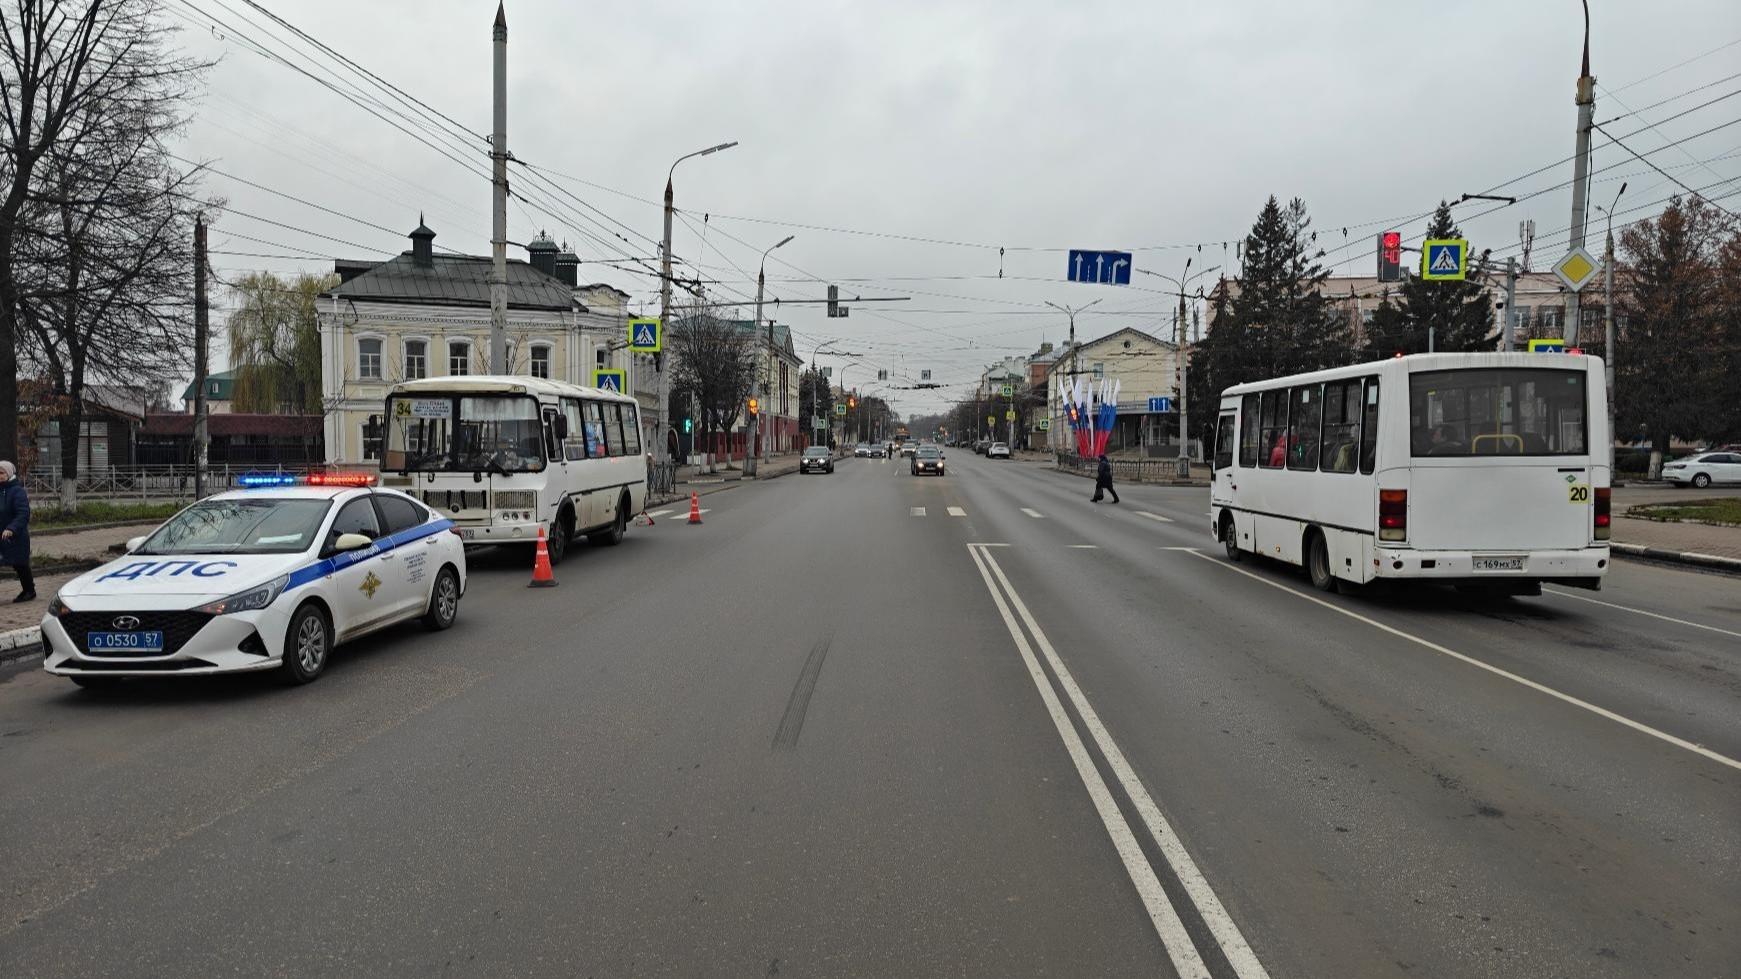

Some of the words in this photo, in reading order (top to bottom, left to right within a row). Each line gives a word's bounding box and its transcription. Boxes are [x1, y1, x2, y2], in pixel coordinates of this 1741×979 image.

[396, 402, 412, 416] 34
[1570, 486, 1588, 502] 20
[94, 560, 238, 584] ДПС
[106, 634, 138, 647] 0530
[145, 633, 158, 643] 57
